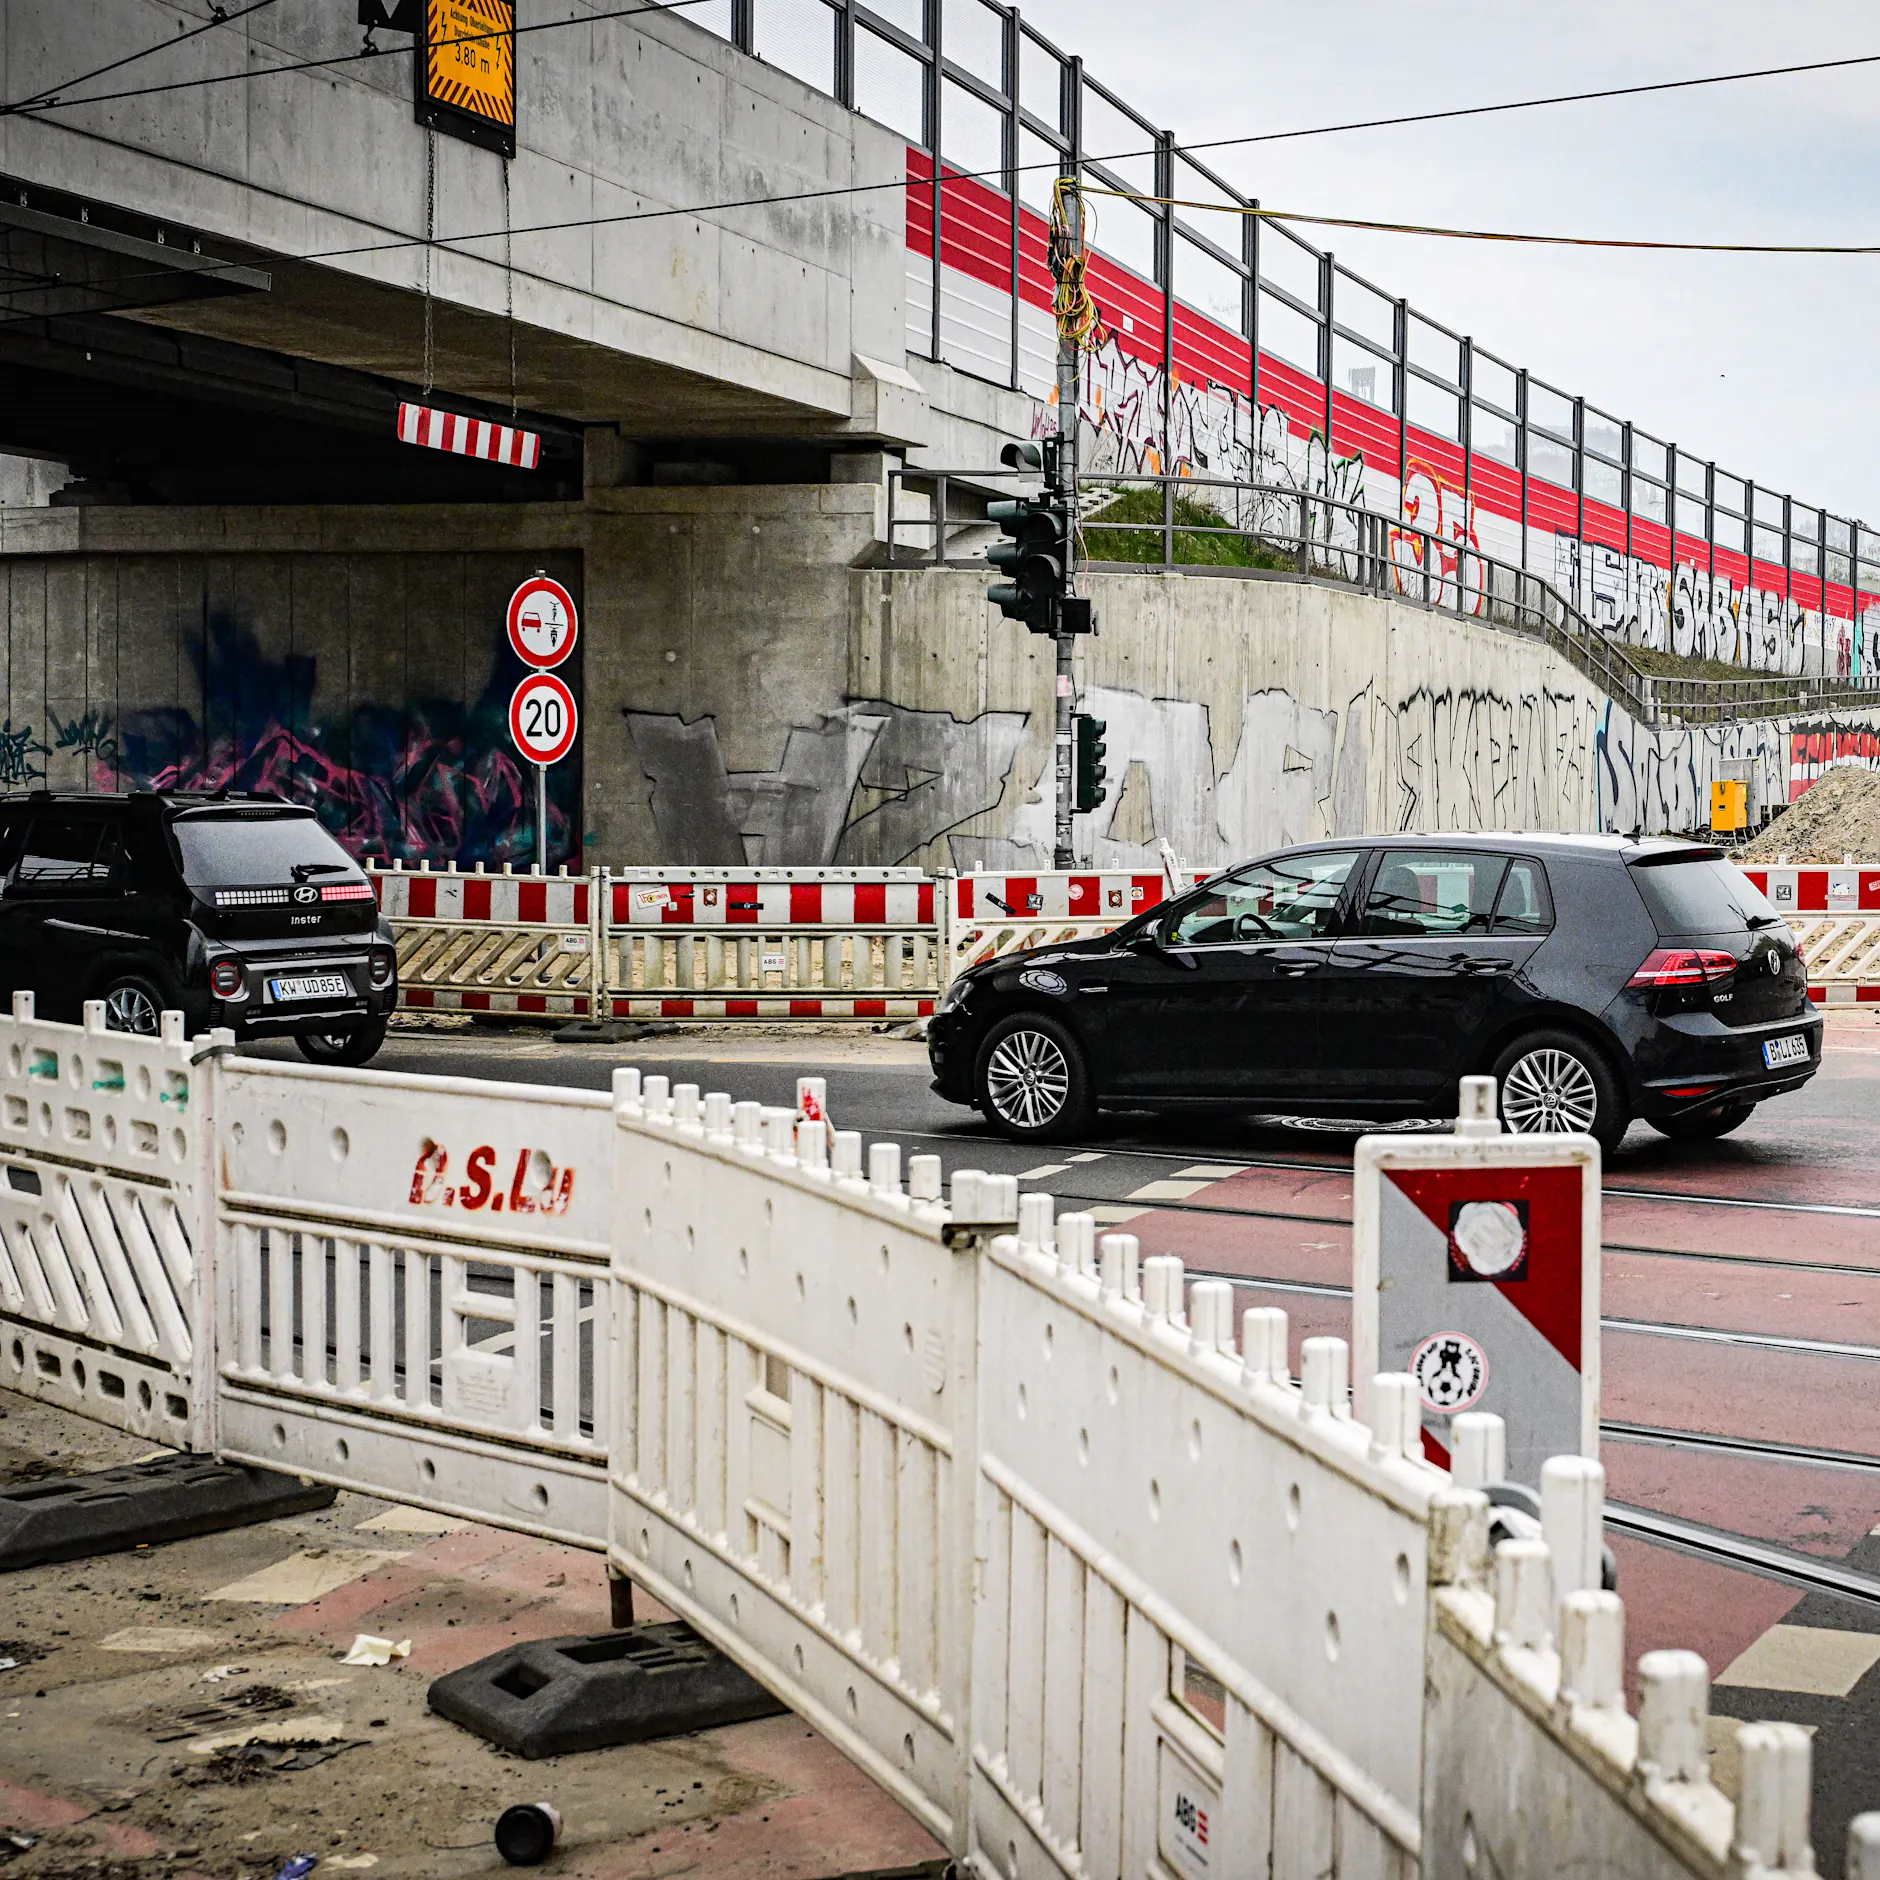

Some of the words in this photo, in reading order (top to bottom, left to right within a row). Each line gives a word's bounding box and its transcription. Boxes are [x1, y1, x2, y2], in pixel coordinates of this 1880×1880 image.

[525, 698, 561, 737] 20
[279, 979, 297, 996] KW
[1713, 993, 1734, 1003] GOLF
[1769, 1043, 1777, 1061] B
[1791, 1036, 1805, 1057] 635
[1175, 1792, 1197, 1833] ABG
